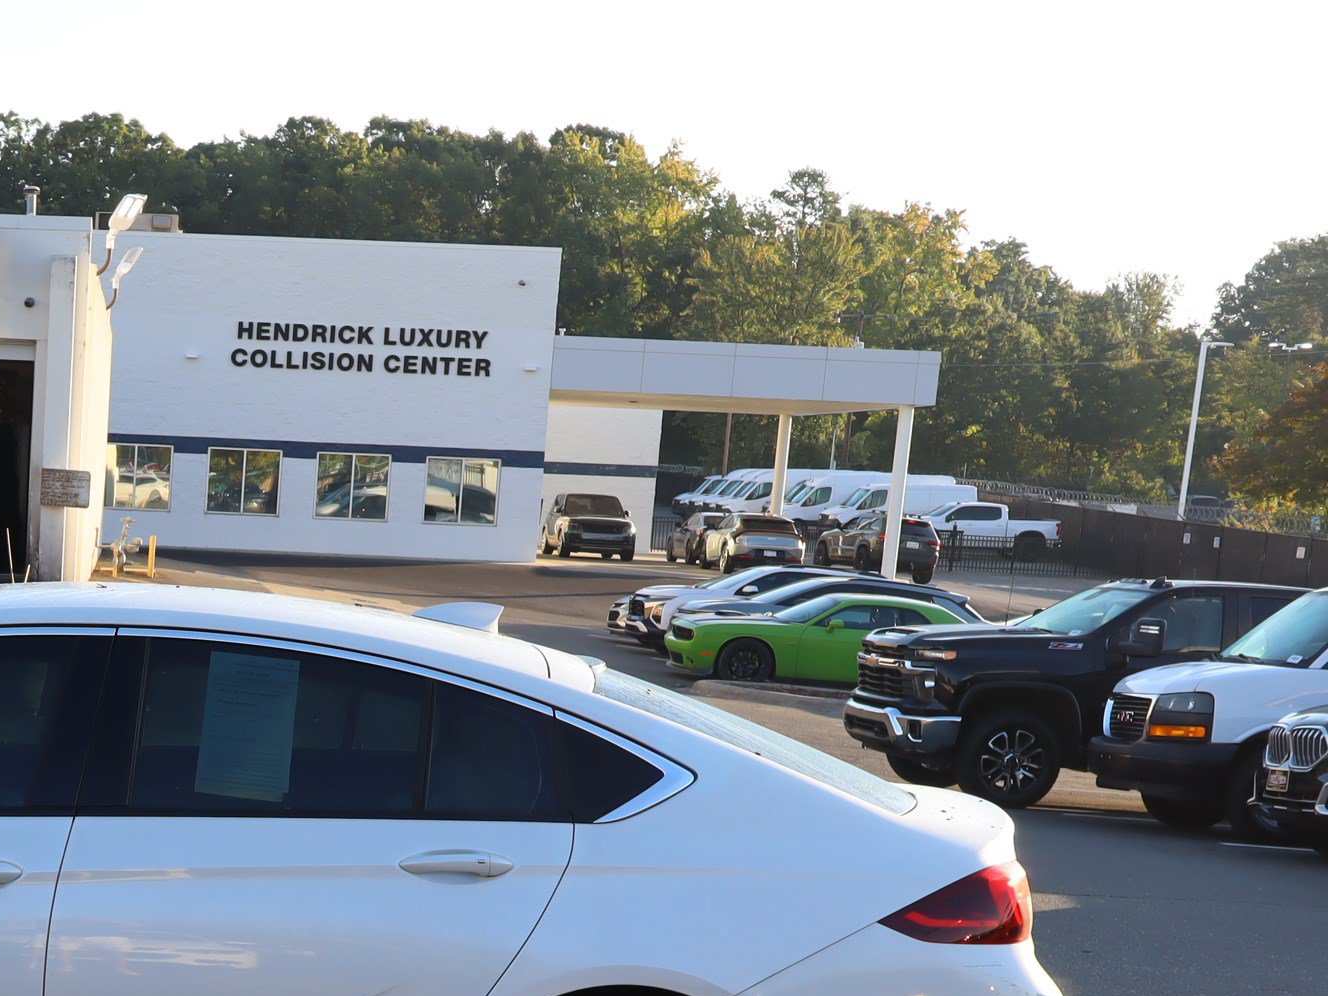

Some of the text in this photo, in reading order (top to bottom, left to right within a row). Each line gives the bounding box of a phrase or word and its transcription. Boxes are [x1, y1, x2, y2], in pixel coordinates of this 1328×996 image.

[237, 321, 489, 349] HENDRICK LUXURY
[230, 348, 491, 377] COLLISION CENTER
